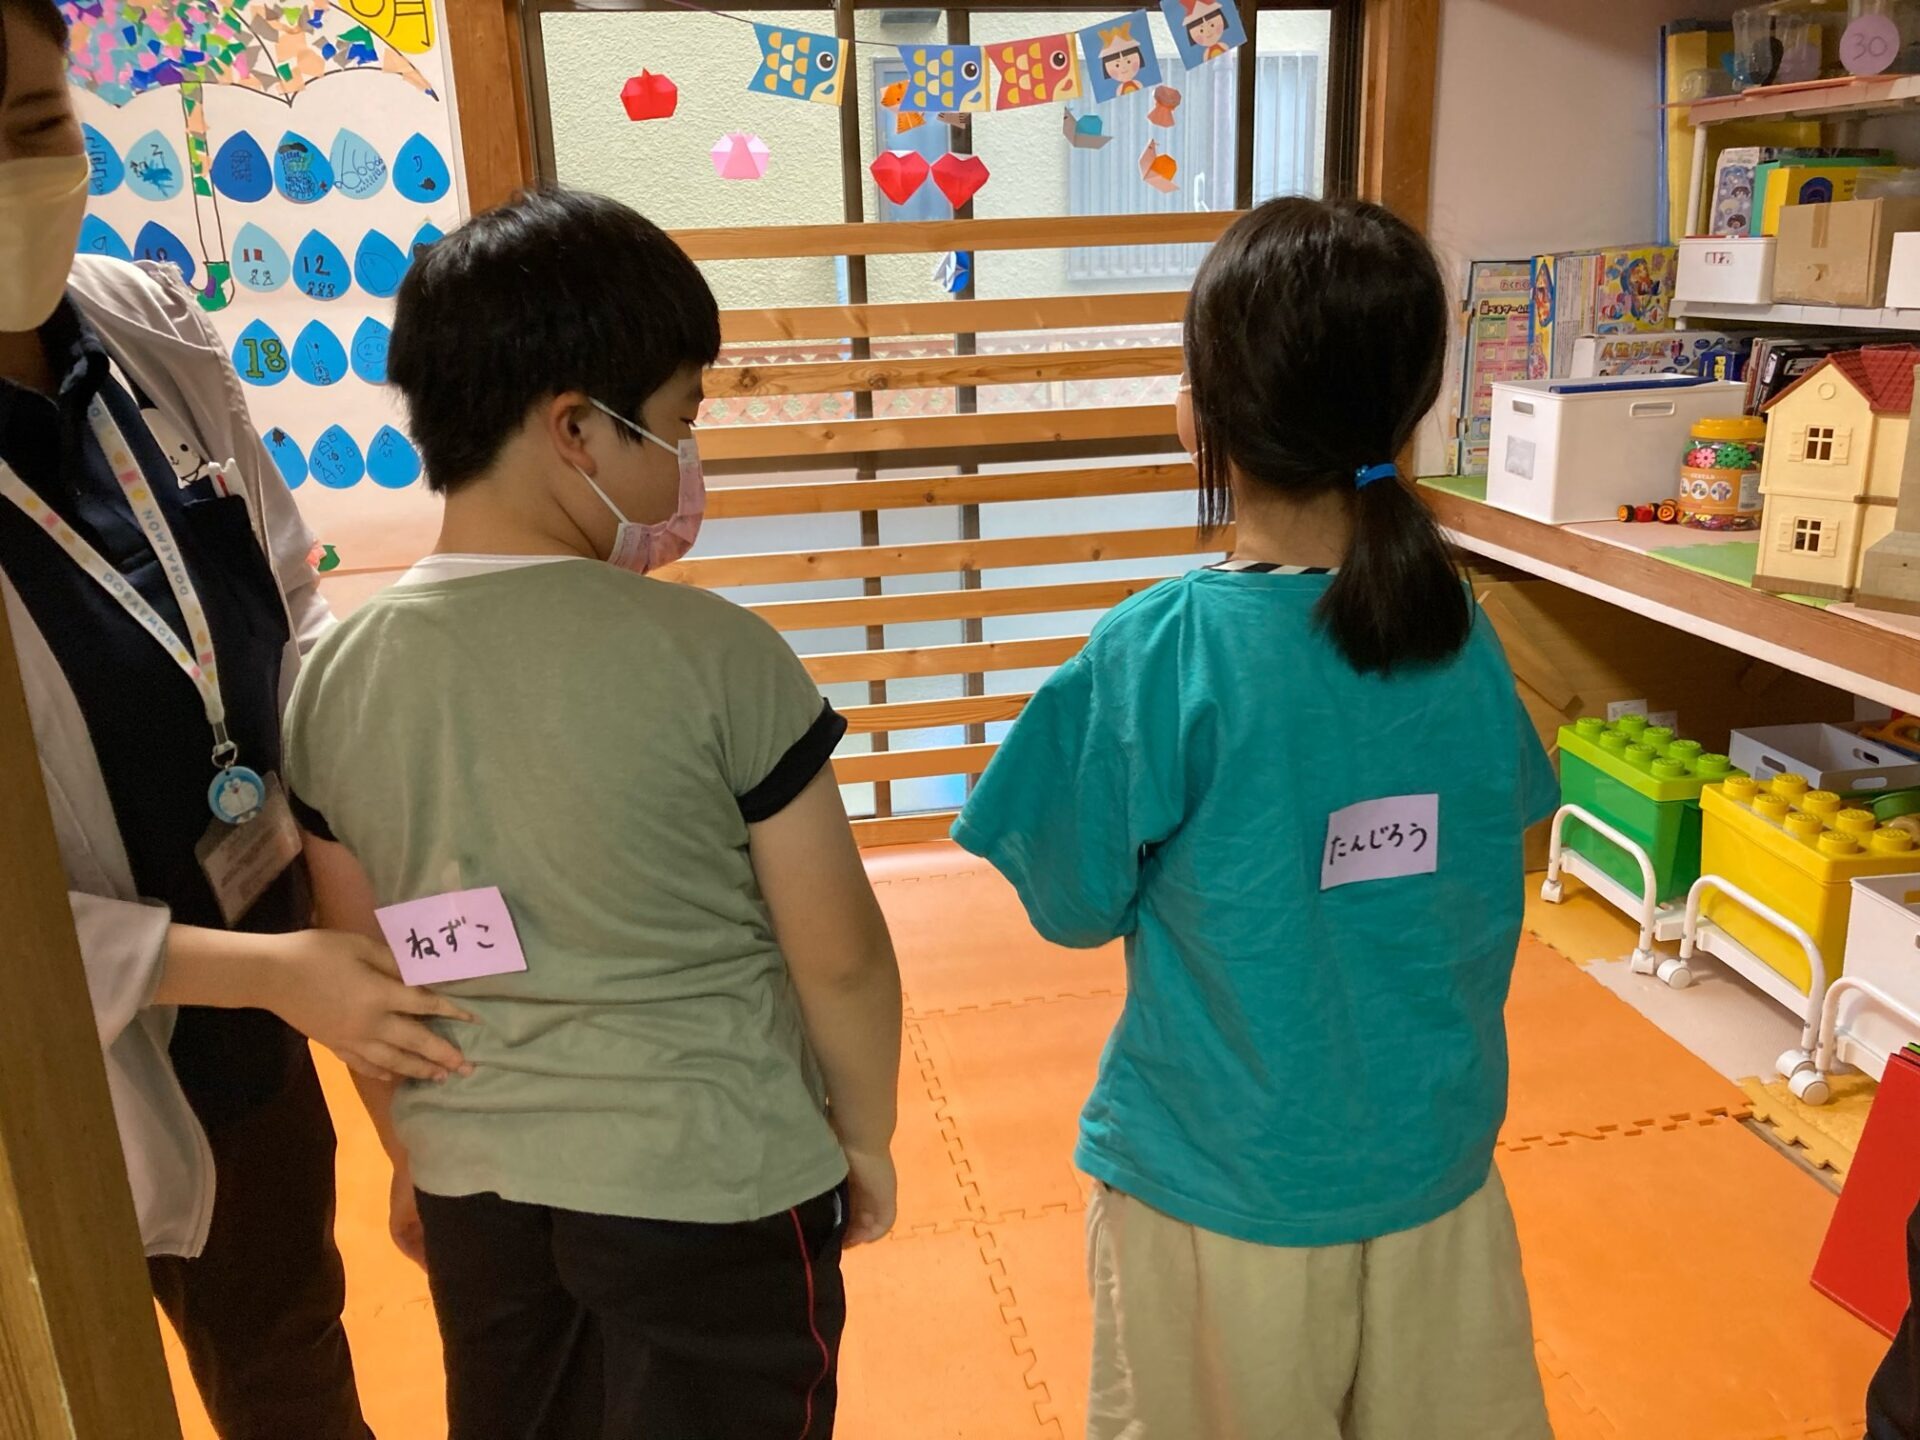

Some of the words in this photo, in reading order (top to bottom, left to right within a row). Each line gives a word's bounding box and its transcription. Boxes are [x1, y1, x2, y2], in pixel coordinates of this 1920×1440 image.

[1852, 33, 1889, 60] 30
[303, 254, 331, 276] 12
[242, 338, 287, 379] 18
[142, 509, 189, 597] DORAEMON
[1329, 822, 1428, 866] たんじろう
[405, 915, 495, 960] ねずこ
